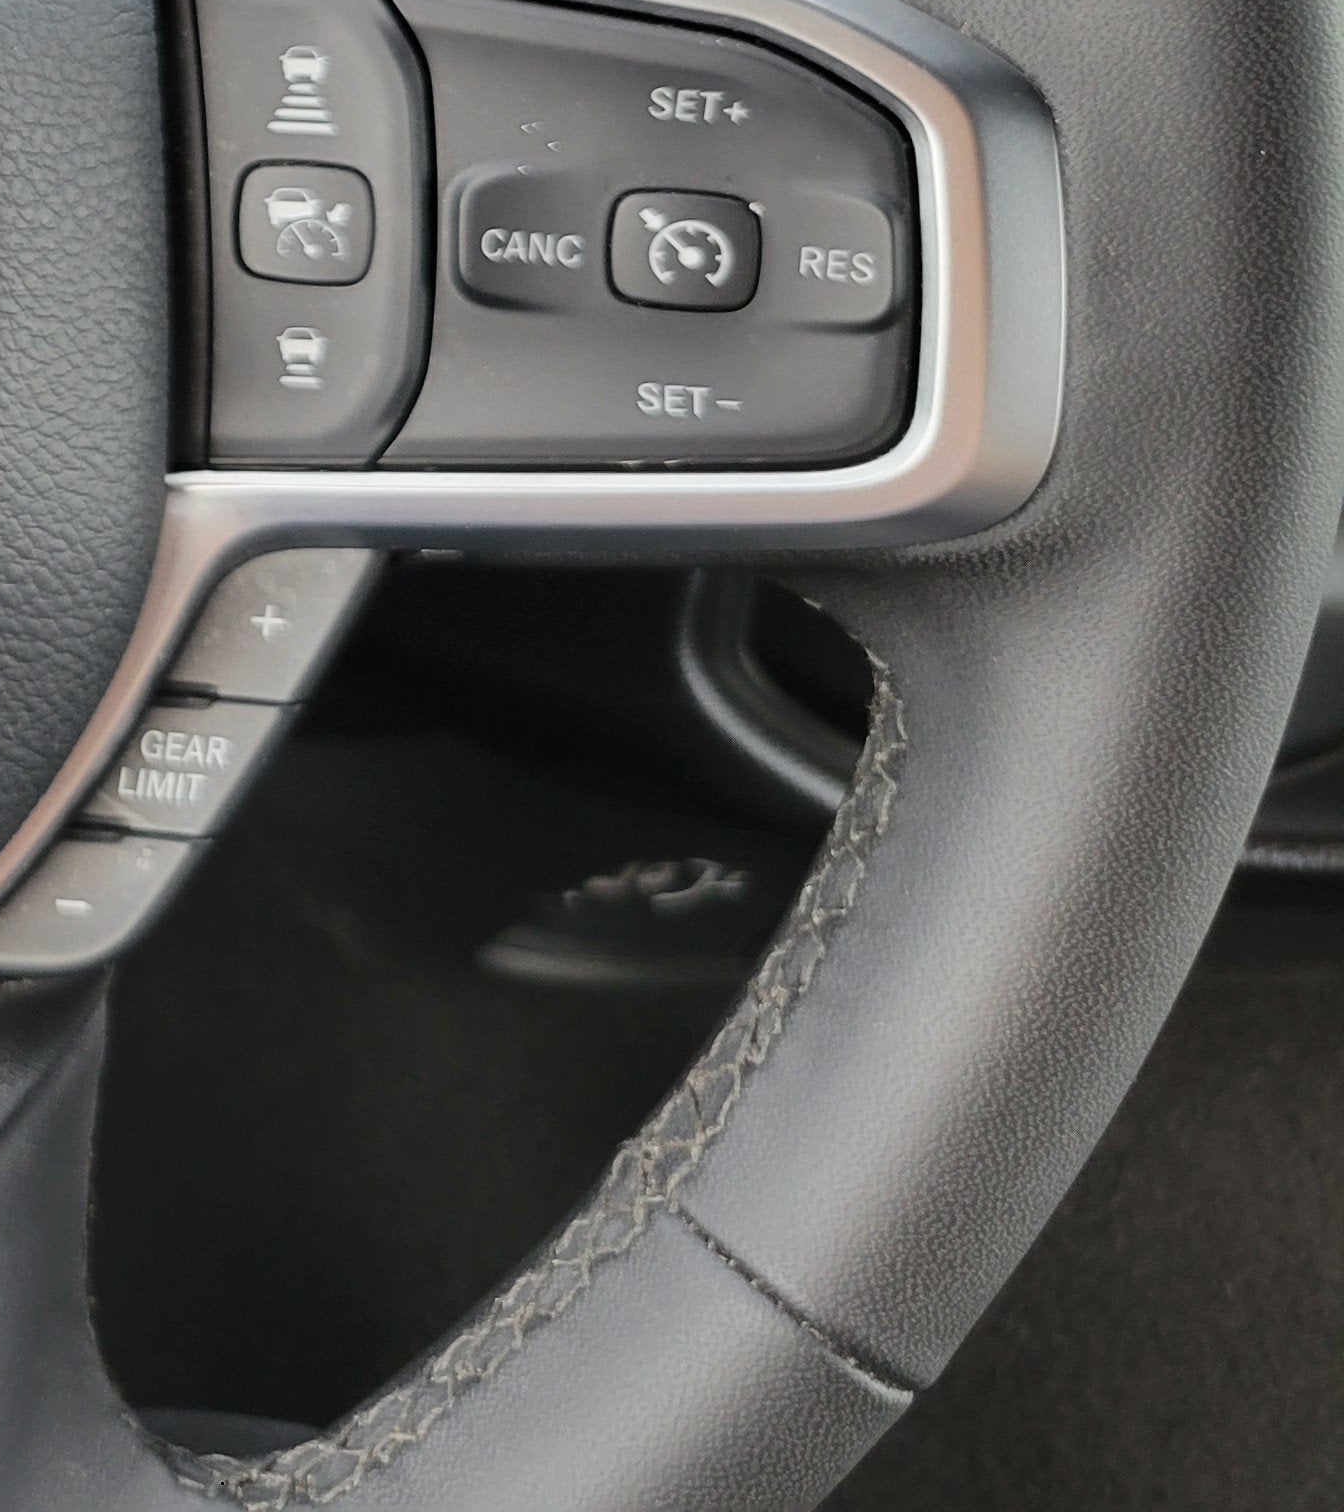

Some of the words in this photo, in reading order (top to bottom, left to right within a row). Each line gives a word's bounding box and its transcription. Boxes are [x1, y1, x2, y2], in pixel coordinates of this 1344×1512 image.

[481, 228, 586, 269] CANC
[799, 245, 875, 284] RES
[139, 730, 230, 769] GEAR
[117, 767, 214, 806] LIMIT
